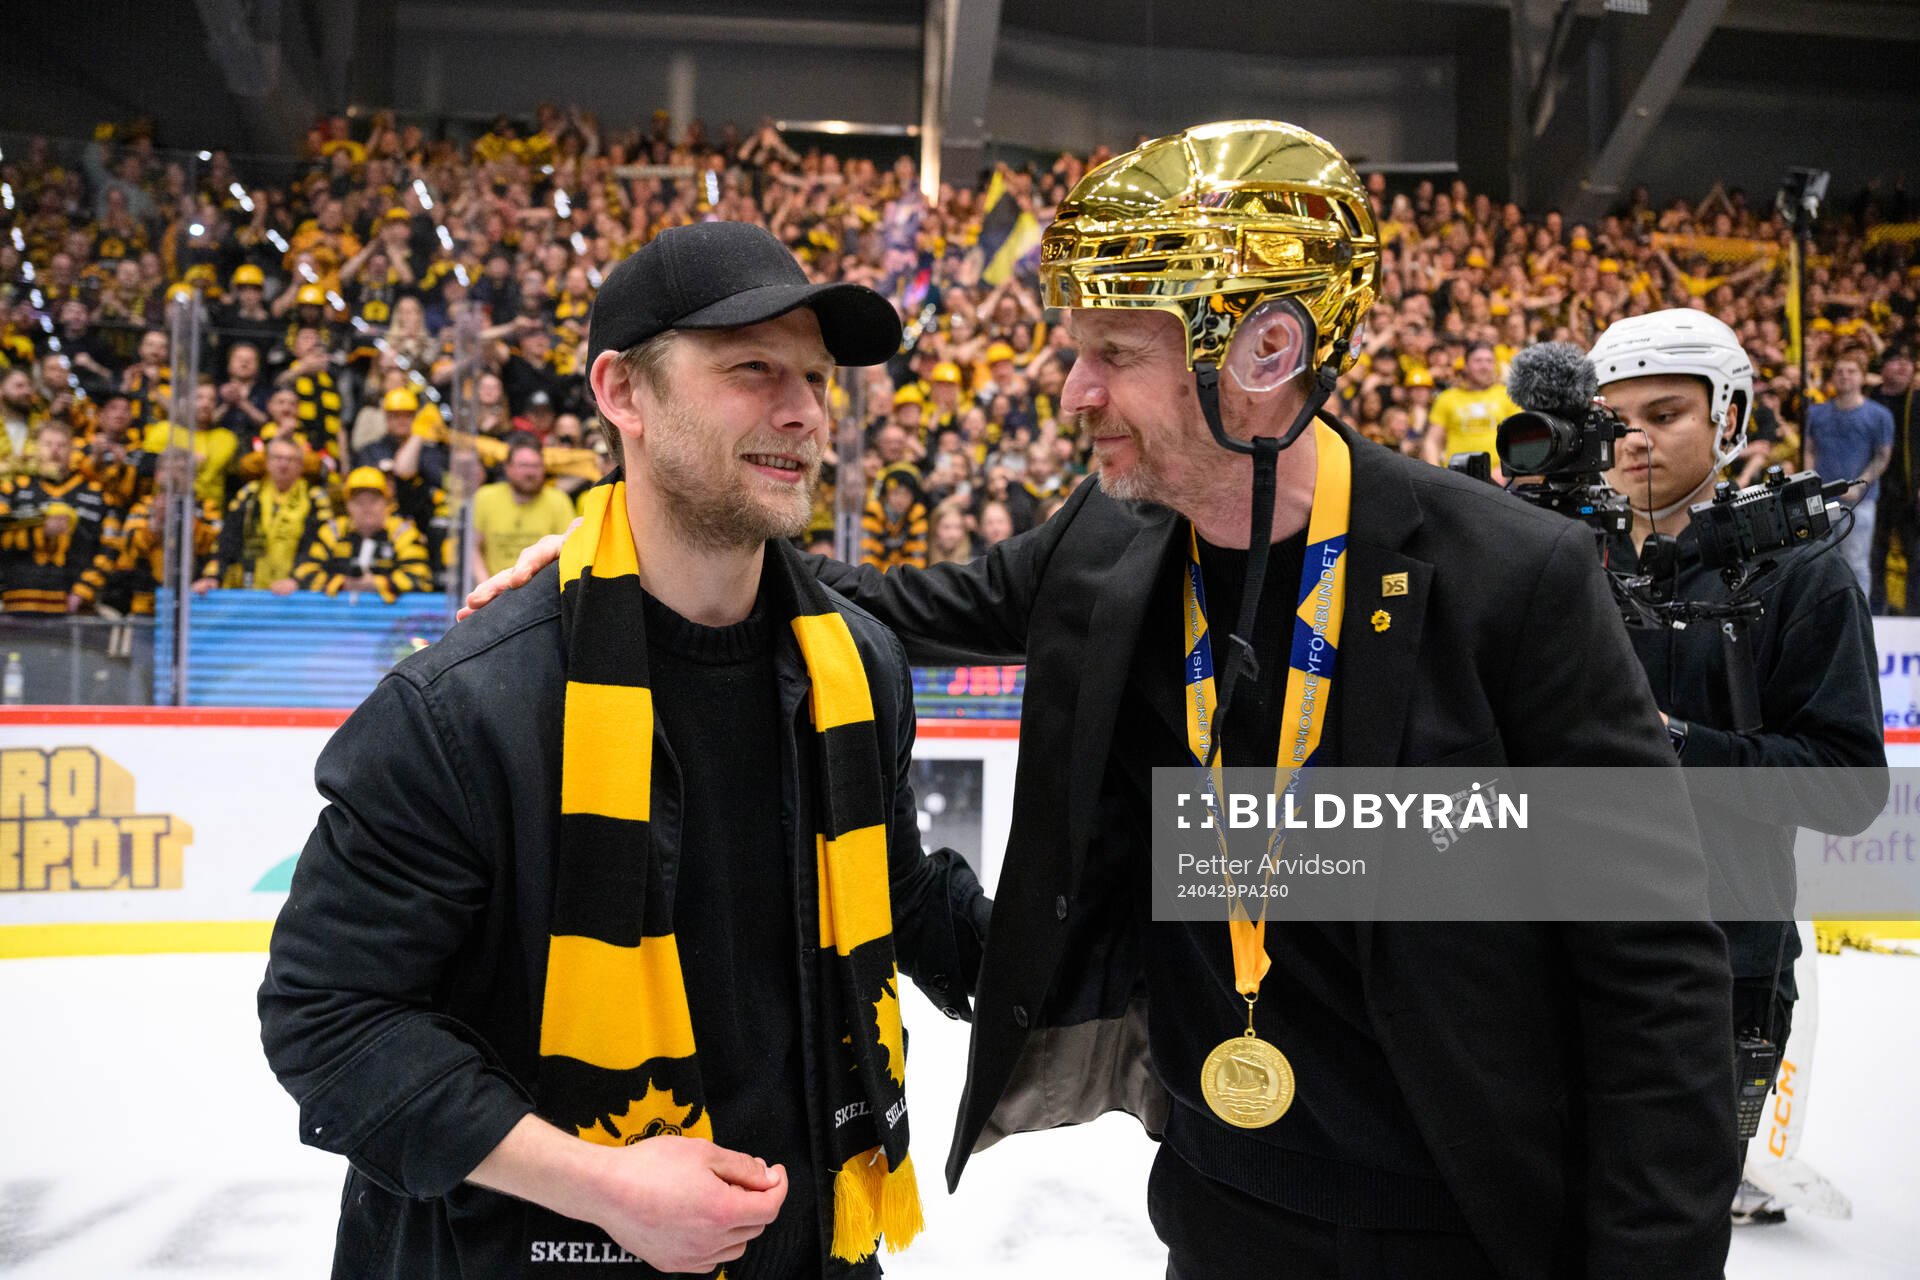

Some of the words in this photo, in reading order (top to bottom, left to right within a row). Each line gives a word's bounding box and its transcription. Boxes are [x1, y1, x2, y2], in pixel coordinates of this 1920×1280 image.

[1292, 544, 1338, 762] ISHOCKEYFÖRBUNDET
[1822, 831, 1916, 864] Kraft
[834, 1101, 872, 1129] SKEL
[1769, 1059, 1797, 1157] CCM
